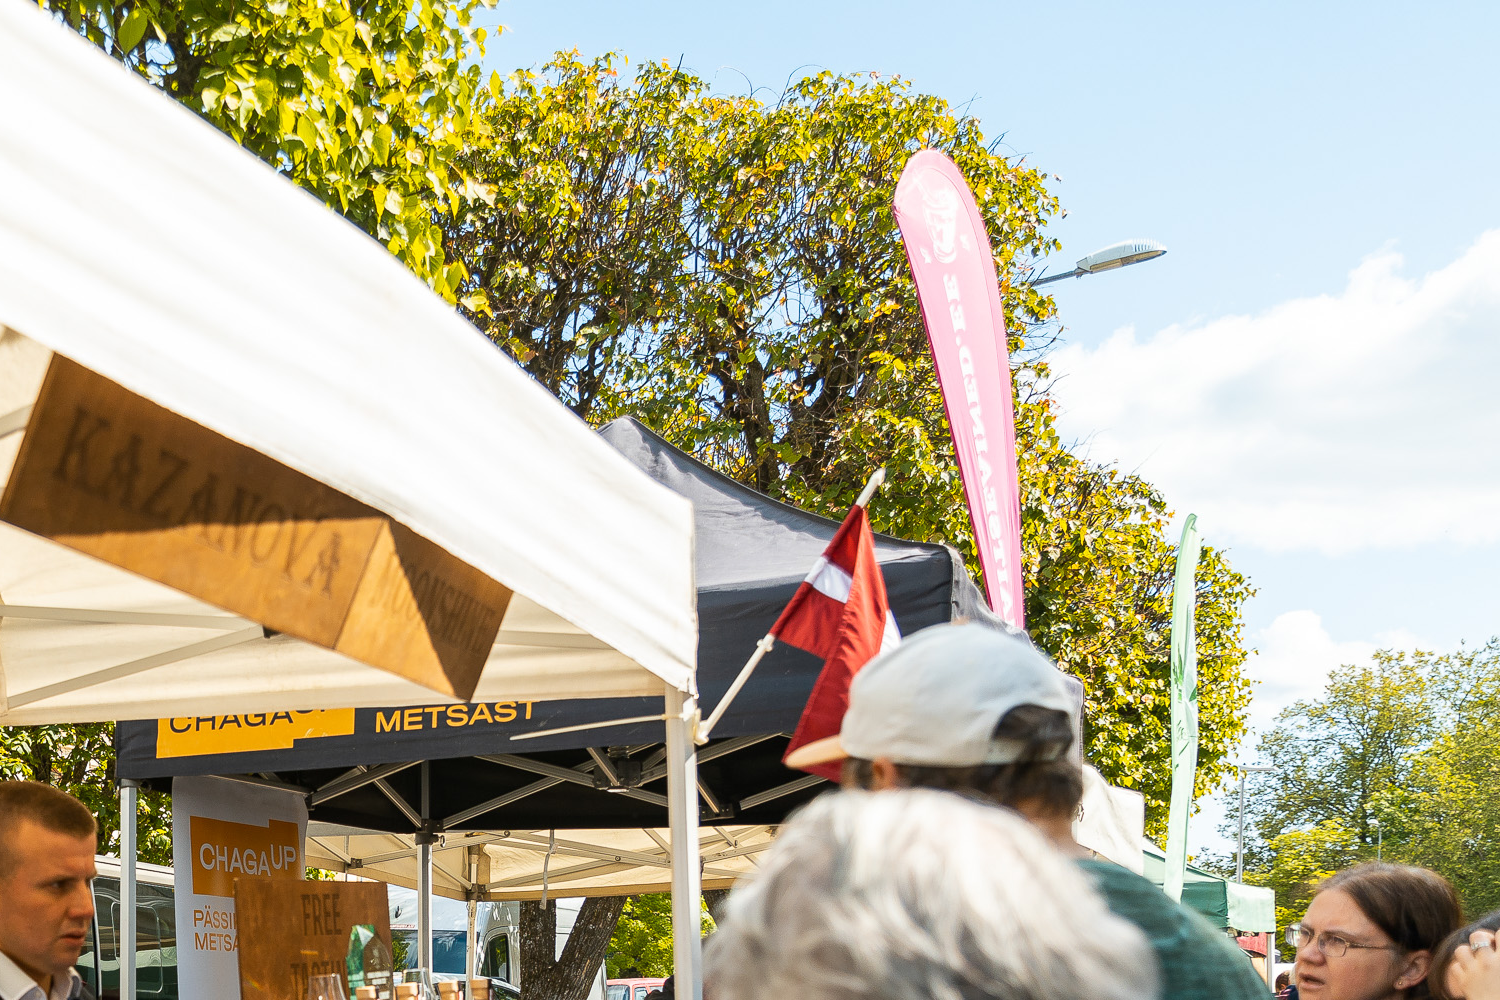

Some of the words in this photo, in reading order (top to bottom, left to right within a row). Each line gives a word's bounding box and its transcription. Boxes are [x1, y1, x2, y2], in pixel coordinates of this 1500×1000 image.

[53, 405, 341, 598] KAZANOVA
[169, 709, 326, 733] CHAGA
[375, 701, 540, 733] METSAST
[200, 843, 297, 877] CHAGAUP
[301, 894, 342, 936] FREE
